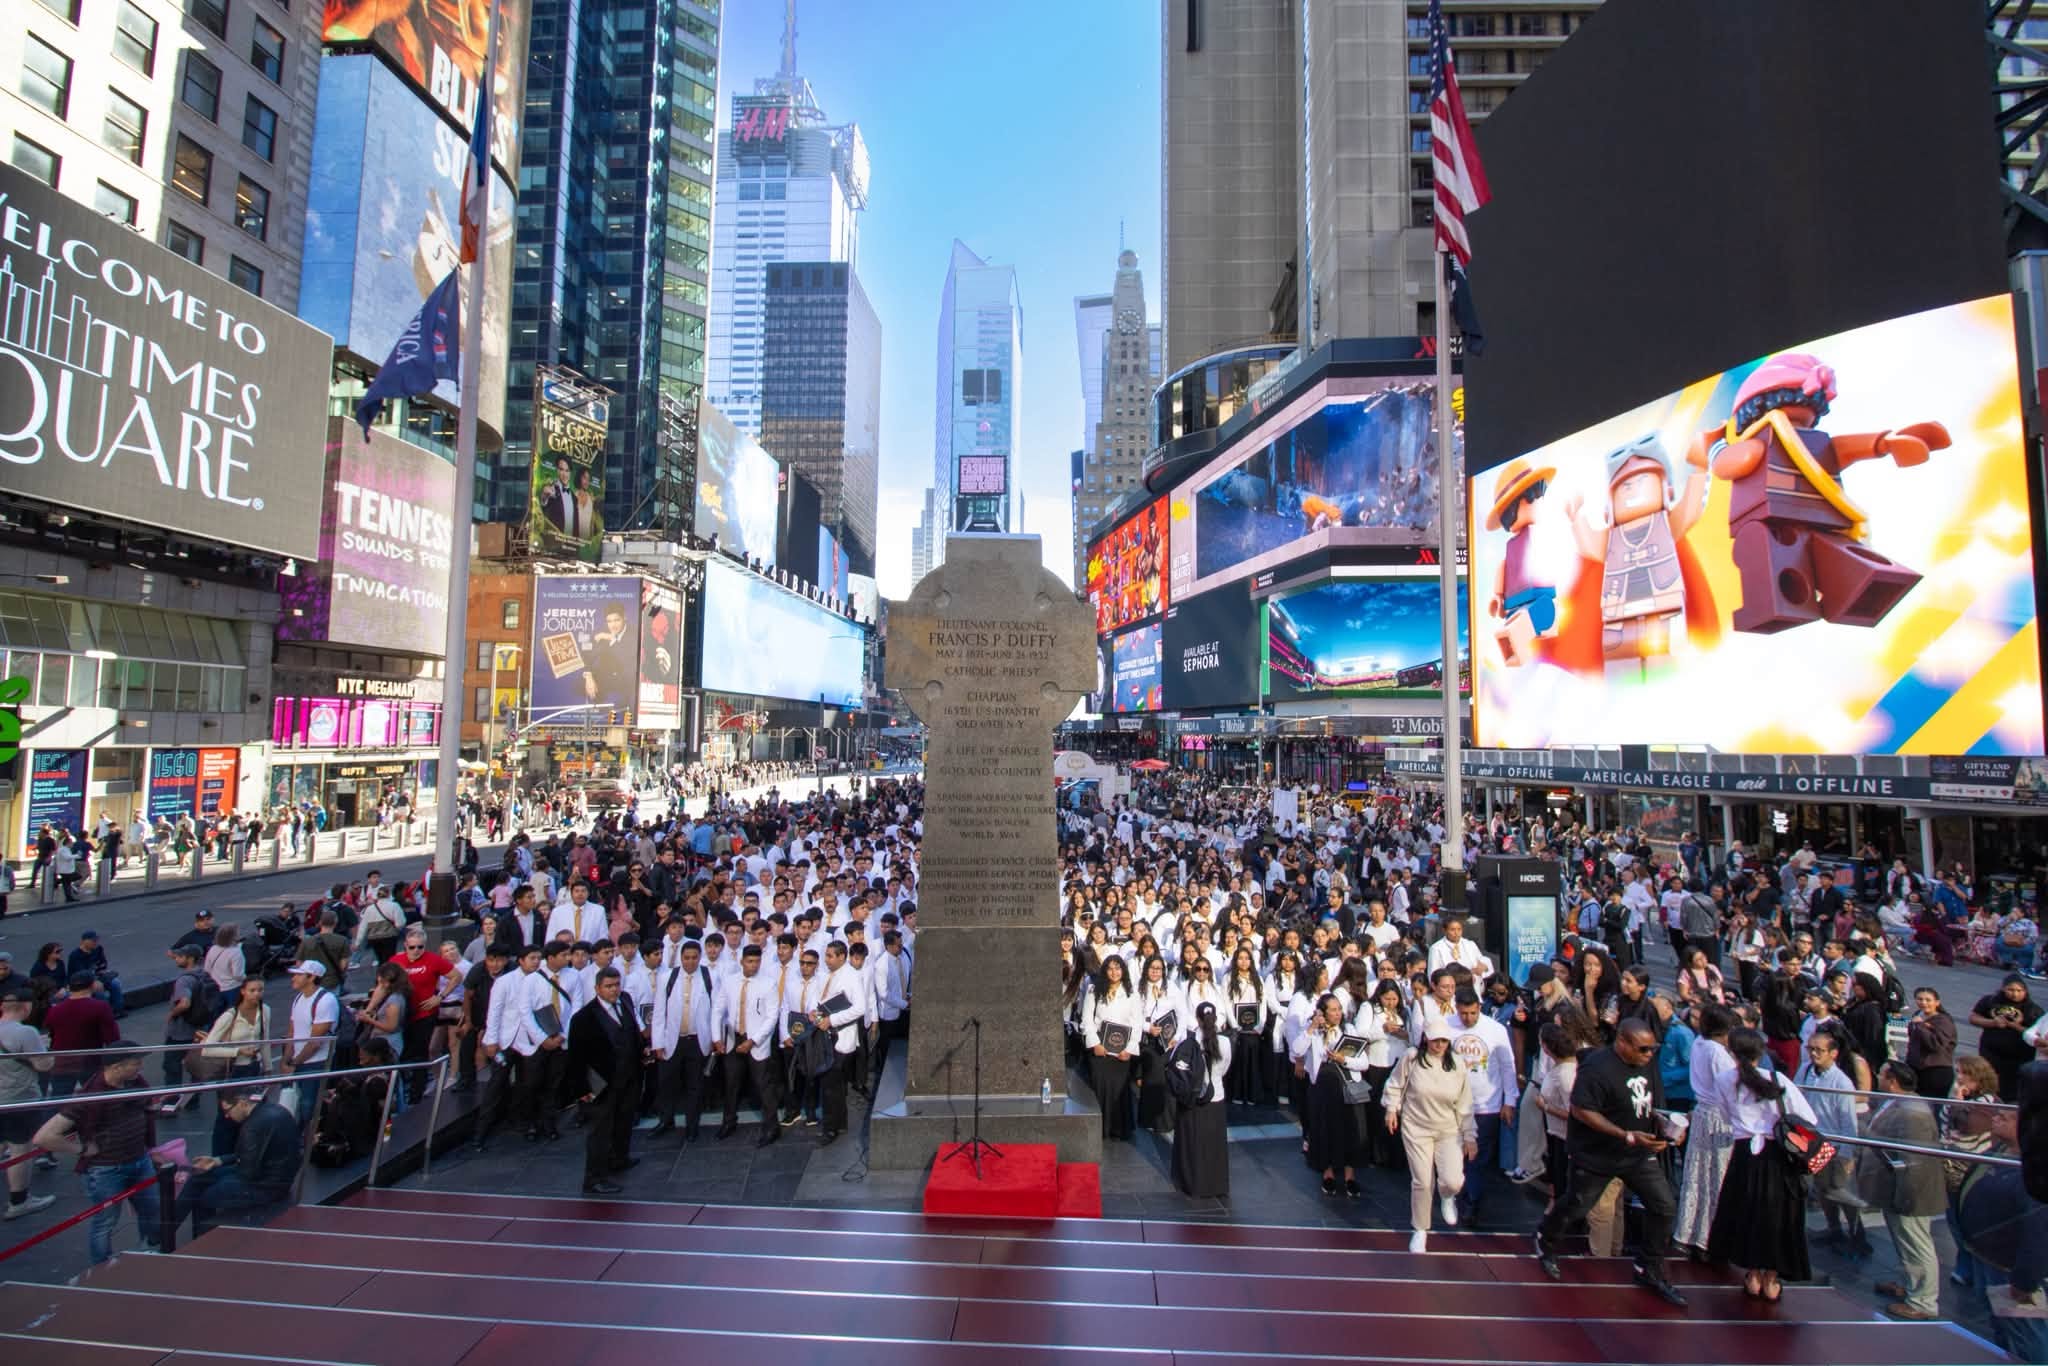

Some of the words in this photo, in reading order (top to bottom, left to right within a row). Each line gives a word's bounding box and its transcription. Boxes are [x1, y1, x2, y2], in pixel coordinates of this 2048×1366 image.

[735, 107, 787, 143] H&M
[0, 192, 208, 332] ELCOME
[216, 309, 266, 355] TO
[92, 318, 262, 430] TIMES
[541, 408, 564, 435] THE
[566, 422, 606, 451] GREAT
[548, 432, 599, 464] GATSBY
[343, 532, 414, 562] SOUNDS
[543, 608, 596, 617] JEREMY
[542, 618, 595, 631] JORDAN
[937, 619, 996, 630] LIEUTENANT
[1000, 621, 1048, 631] COLONEL
[929, 632, 988, 646] FRANCIS
[1008, 634, 1057, 647] DUFFY
[936, 650, 955, 658] MAY
[1184, 643, 1211, 658] AVAILABLE
[1212, 641, 1220, 653] AT
[1184, 654, 1219, 672] SEPHORA
[944, 666, 995, 676] CATHOLIC
[1002, 667, 1040, 677] PRIEST
[337, 678, 364, 694] NYC
[967, 692, 1017, 702] CHAPLAIN
[956, 720, 977, 729] OLD
[1176, 721, 1200, 731] SEPHORA
[1226, 719, 1246, 732] Mobile
[1408, 718, 1444, 733] Mobi
[1000, 747, 1040, 756] SERVICE
[993, 767, 1042, 777] COUNTRY
[1398, 763, 1437, 772] AMERICAN
[1964, 761, 1991, 770] GIFTS
[1992, 762, 2011, 771] AND
[1508, 767, 1554, 779] OFFLINE
[1968, 770, 2009, 778] APPAREL
[1583, 771, 1654, 785] AMERICAN
[1662, 774, 1711, 788] EAGLE
[1736, 776, 1767, 791] aerie
[1796, 777, 1893, 795] OFFLINE
[960, 831, 994, 840] WORLD
[1518, 936, 1547, 945] WATER
[1518, 945, 1546, 953] REFILL
[1521, 954, 1544, 962] HERE
